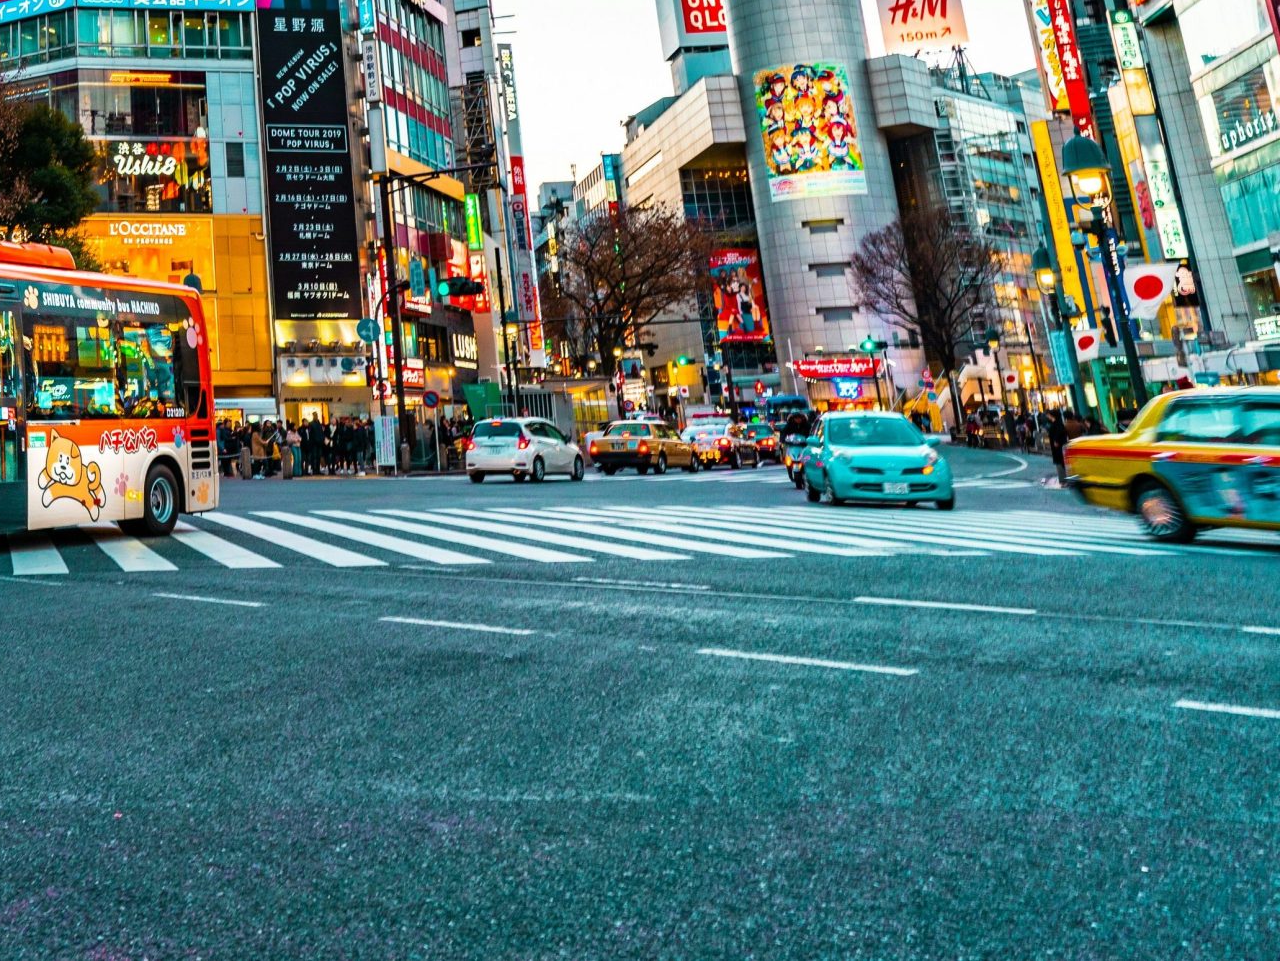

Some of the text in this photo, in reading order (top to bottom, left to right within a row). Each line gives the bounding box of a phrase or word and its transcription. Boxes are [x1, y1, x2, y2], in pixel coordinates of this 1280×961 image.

[273, 16, 325, 32] 星野源
[276, 48, 305, 79] NEW ALBUM
[291, 60, 339, 112] NOW ON SALE!
[271, 129, 341, 138] DOME TOUR 2019
[113, 155, 176, 176] Ushi8
[109, 222, 186, 236] L'OCCITANE
[42, 292, 160, 315] SHIBUYA community bus HACHIKO
[453, 332, 477, 360] LUSH
